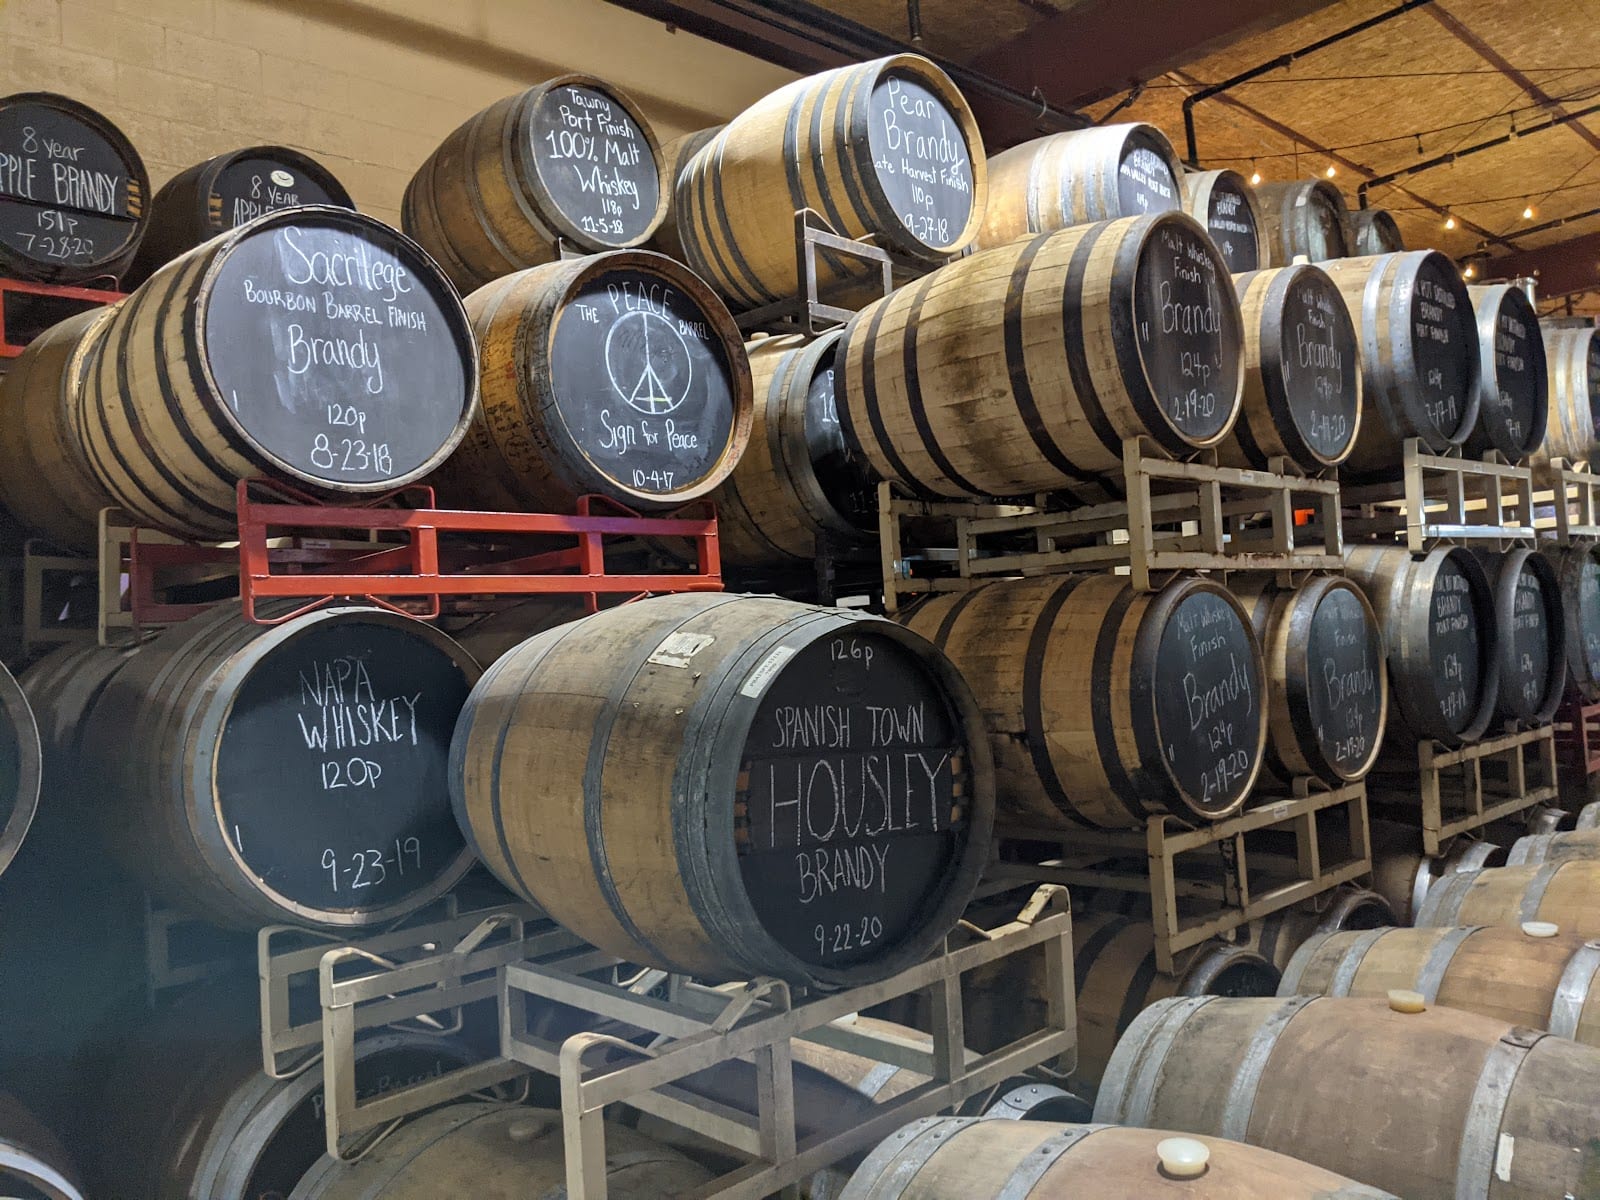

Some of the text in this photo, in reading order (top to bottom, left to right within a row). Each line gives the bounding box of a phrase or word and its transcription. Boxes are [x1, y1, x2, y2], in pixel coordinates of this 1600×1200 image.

[567, 88, 611, 121] Tawny
[887, 75, 935, 120] Pear
[559, 105, 634, 139] Port Finish
[884, 109, 965, 175] Brandy
[22, 126, 85, 161] 8 year
[546, 130, 640, 166] 100% Malt
[0, 152, 118, 215] PPLE BRANDY
[251, 174, 263, 199] 8
[573, 165, 640, 210] Whiskey
[874, 154, 969, 193] ate Harvest Finish
[16, 231, 94, 258] 7-28-20
[905, 213, 950, 243] 9-27-18
[284, 226, 411, 301] Sacrilege
[1173, 256, 1201, 284] Finish
[244, 279, 427, 334] BOURBON BARREL FINISH
[575, 303, 600, 324] THE
[607, 281, 674, 320] PEACE
[679, 319, 709, 340] BARREL
[1160, 280, 1223, 369] Brandy
[288, 324, 383, 394] Brandy
[1180, 352, 1211, 387] 124p
[1297, 322, 1342, 394] Brandy
[327, 403, 366, 434] 120p
[600, 409, 698, 455] Sign for Peace
[311, 433, 392, 474] 8-23-18
[632, 469, 674, 490] 10-4-17
[830, 639, 875, 670] 126p
[1190, 631, 1227, 662] Finish
[299, 655, 375, 706] NAPA
[1183, 652, 1252, 731] Brandy
[1323, 649, 1377, 714] Brandy
[298, 692, 422, 752] WHISKEY
[773, 701, 925, 748] SPANISH TOWN
[1208, 719, 1233, 752] 124p
[1201, 750, 1249, 803] 2-19-20
[770, 751, 951, 847] HOUSLEY
[321, 836, 421, 892] 9-23-19
[796, 843, 890, 904] BRANDY
[814, 916, 882, 956] 9-22-20
